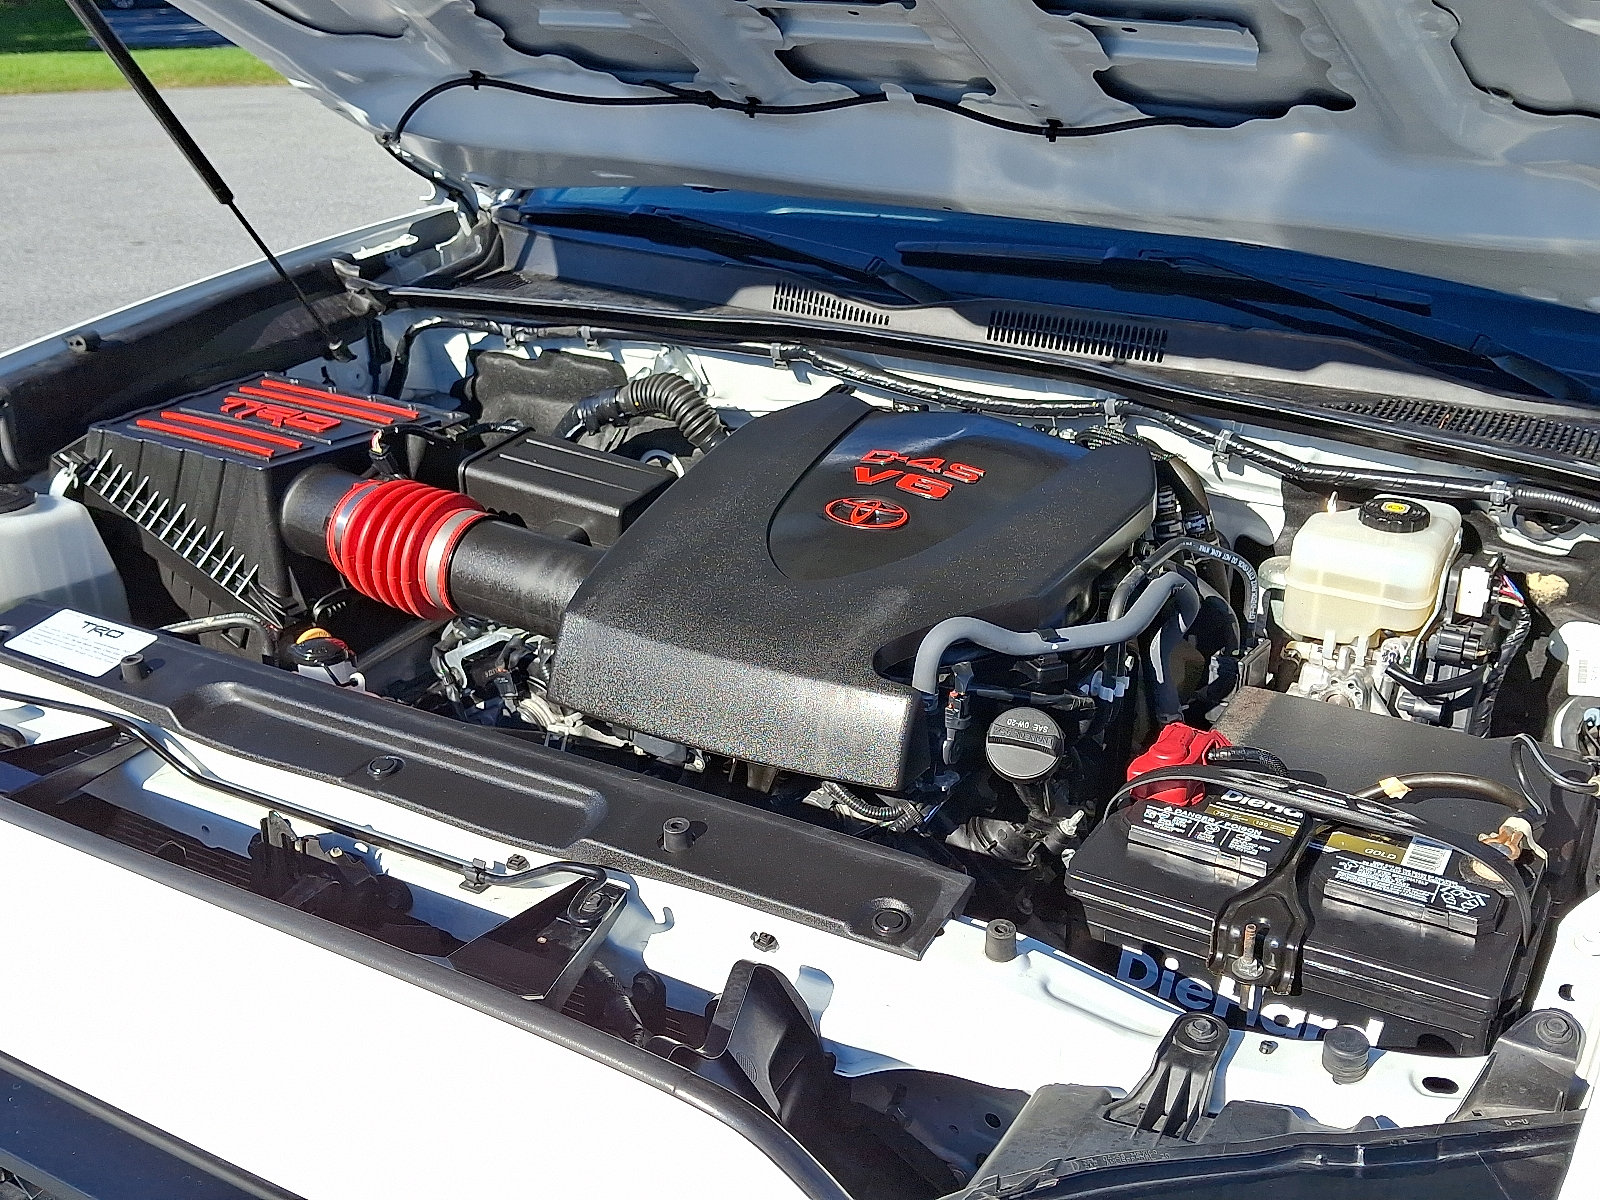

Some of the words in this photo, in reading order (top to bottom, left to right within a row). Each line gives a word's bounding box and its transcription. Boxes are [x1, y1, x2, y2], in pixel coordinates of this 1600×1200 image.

[220, 396, 342, 434] TRD
[860, 449, 987, 484] D-4S
[854, 466, 955, 500] V6
[81, 620, 125, 639] TRD
[1006, 718, 1030, 729] 0W-20
[1033, 723, 1049, 733] SAE
[1220, 789, 1304, 819] DieHa
[1364, 848, 1397, 860] GOLD
